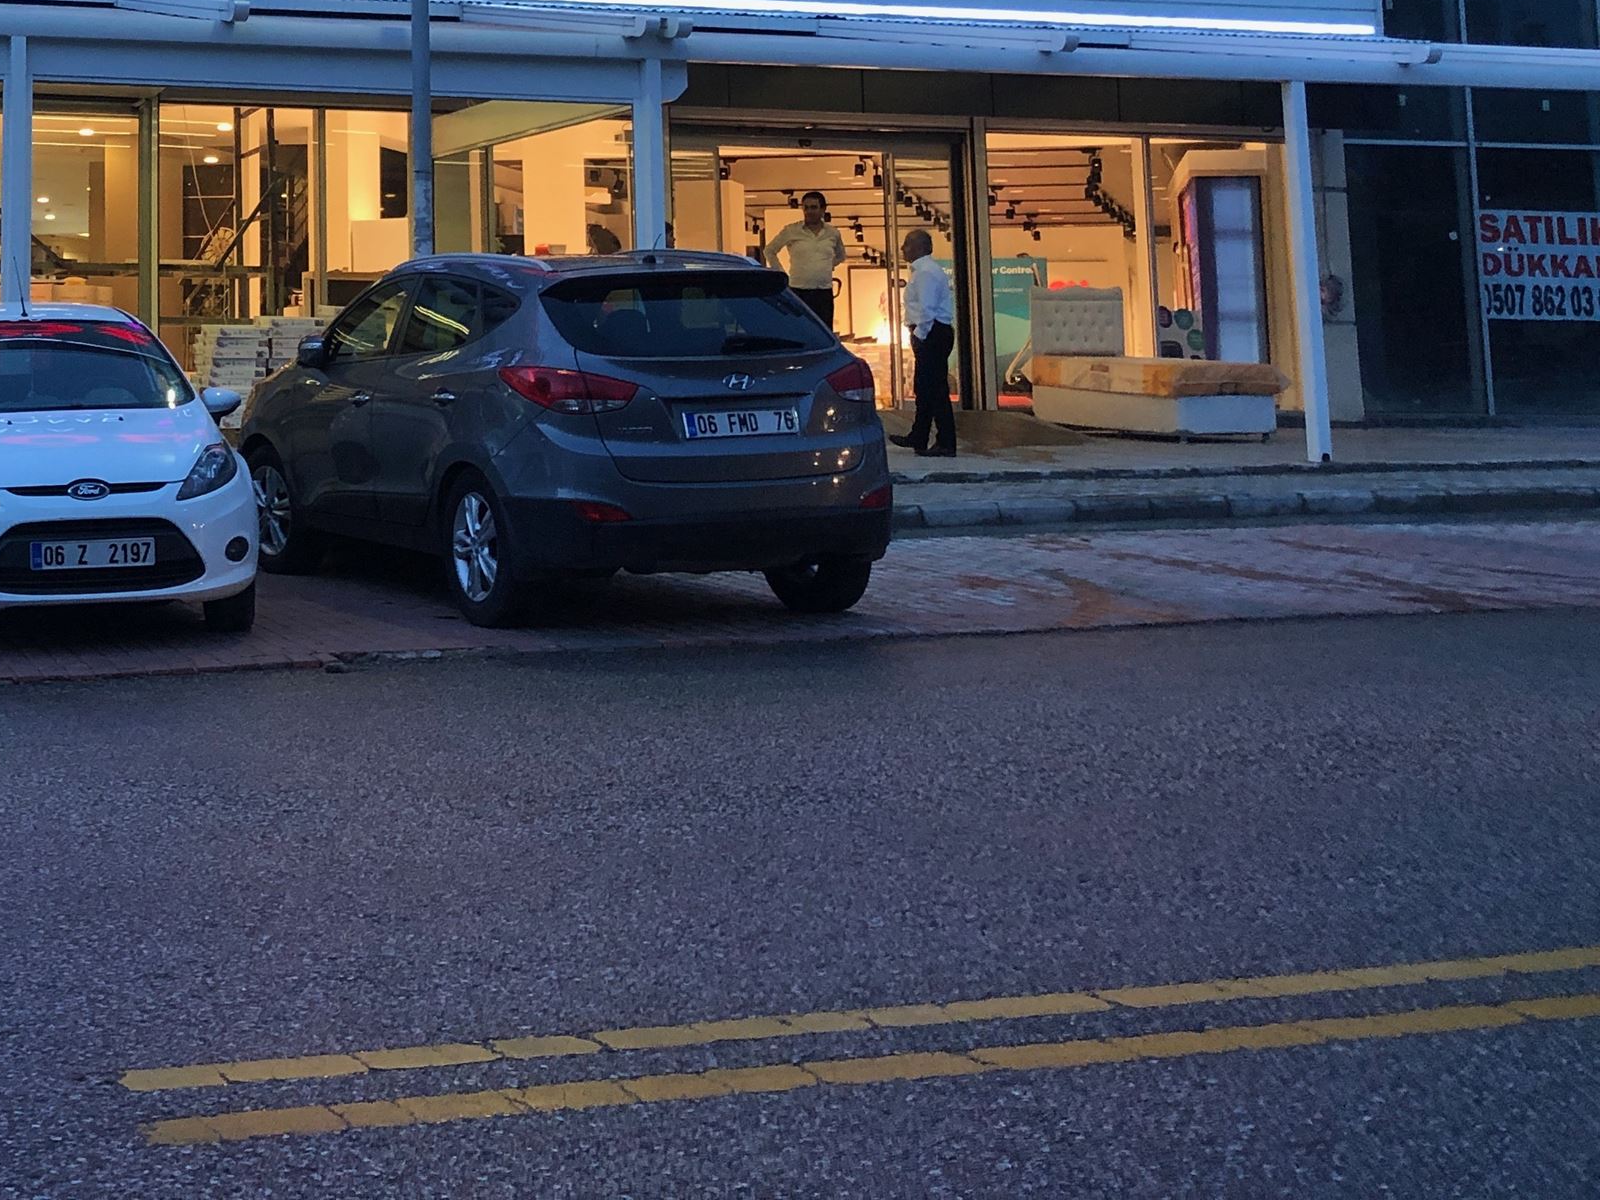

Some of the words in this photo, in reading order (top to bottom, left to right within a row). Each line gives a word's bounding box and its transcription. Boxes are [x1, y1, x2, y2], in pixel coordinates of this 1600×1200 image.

[1482, 246, 1600, 279] DÜKKA
[1532, 285, 1567, 317] 862
[1570, 286, 1595, 318] 03
[696, 415, 718, 435] 06
[727, 412, 759, 433] FMD
[773, 411, 794, 431] 76
[77, 485, 101, 496] Ford
[43, 545, 65, 566] 06
[77, 544, 88, 565] Z
[108, 541, 152, 564] 2197
